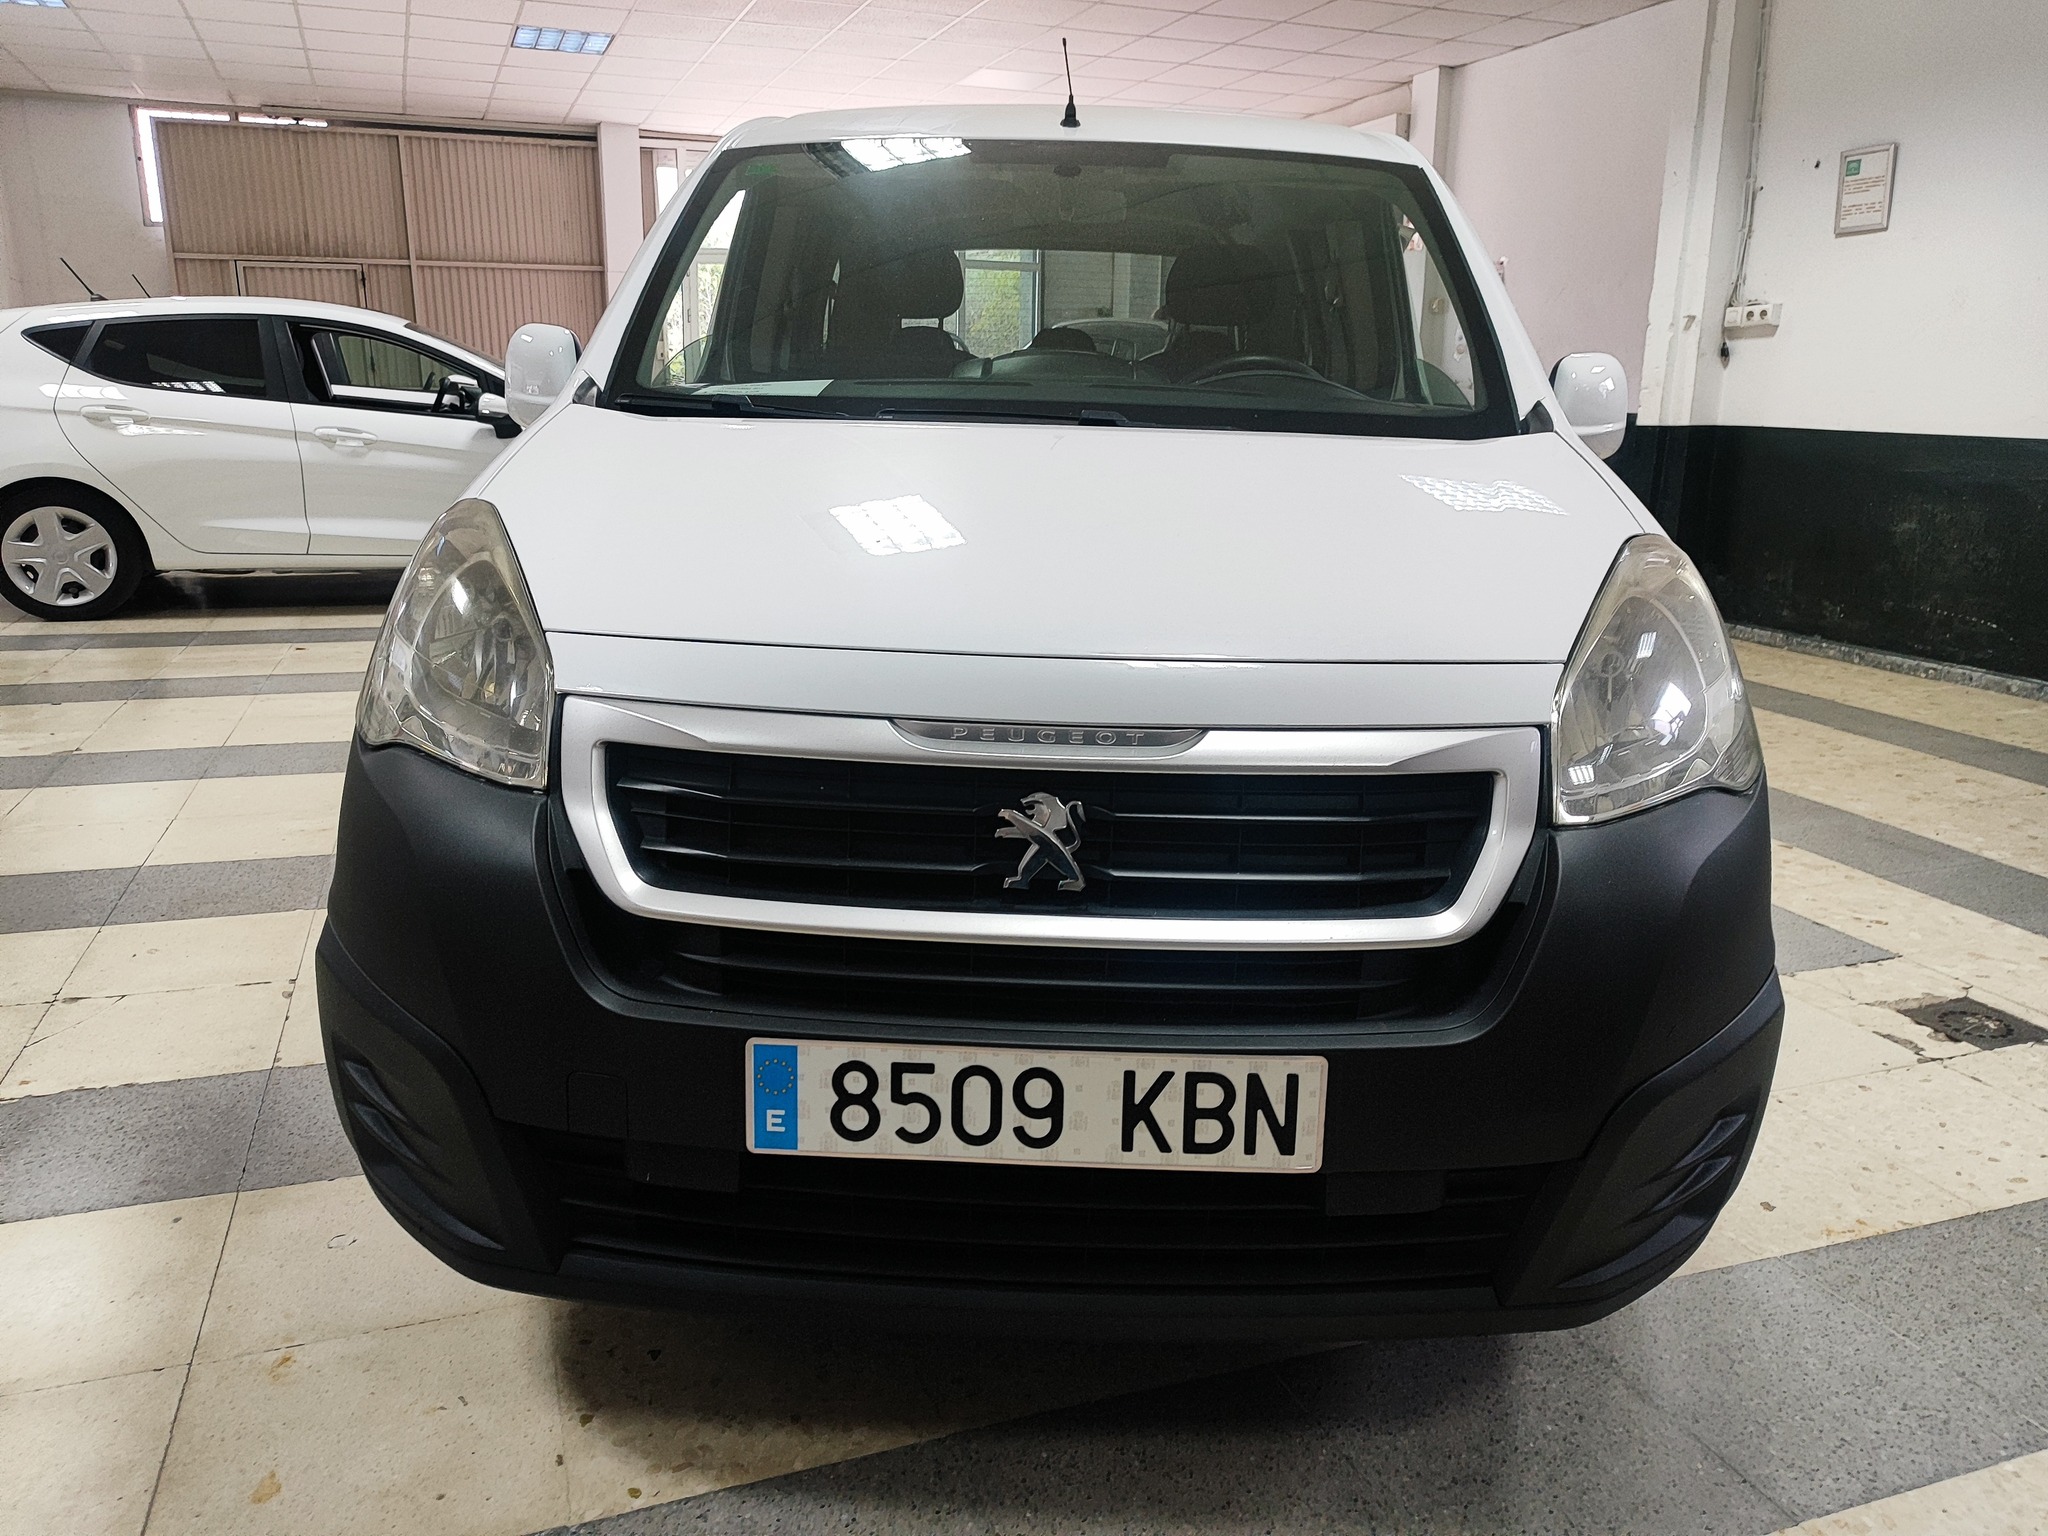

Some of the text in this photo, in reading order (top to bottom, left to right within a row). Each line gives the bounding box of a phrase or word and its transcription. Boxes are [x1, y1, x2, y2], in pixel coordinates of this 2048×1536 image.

[950, 727, 1145, 745] PEUGEOT
[829, 1059, 1299, 1156] 8509 KBN
[766, 1109, 786, 1132] E
